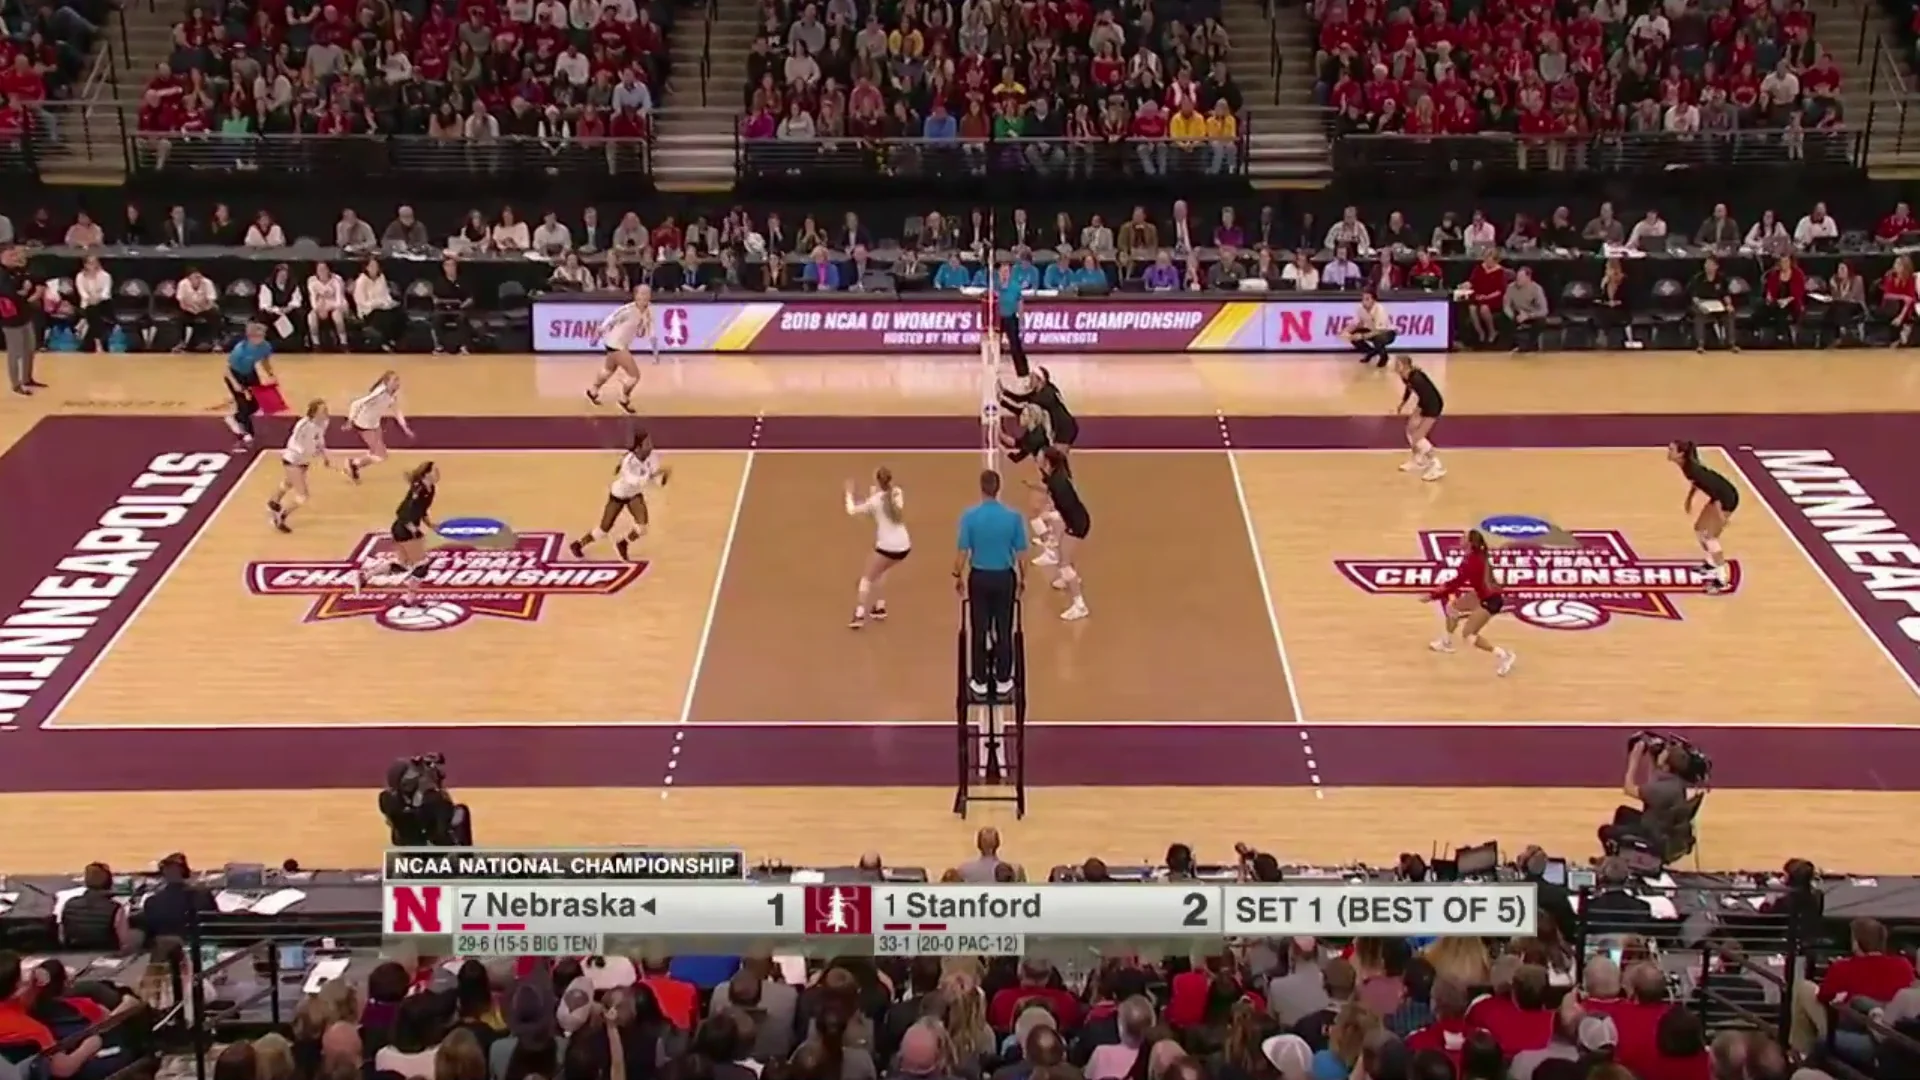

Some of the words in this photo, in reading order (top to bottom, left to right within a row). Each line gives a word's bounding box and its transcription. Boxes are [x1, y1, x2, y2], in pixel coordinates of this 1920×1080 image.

[781, 312, 821, 330] 2018
[823, 312, 868, 330] NCAA
[892, 312, 972, 330] WOMEN'S
[1074, 311, 1203, 330] CHAMPIONSHIP
[1279, 310, 1312, 343] N
[1445, 555, 1626, 568] VLLEYBALL
